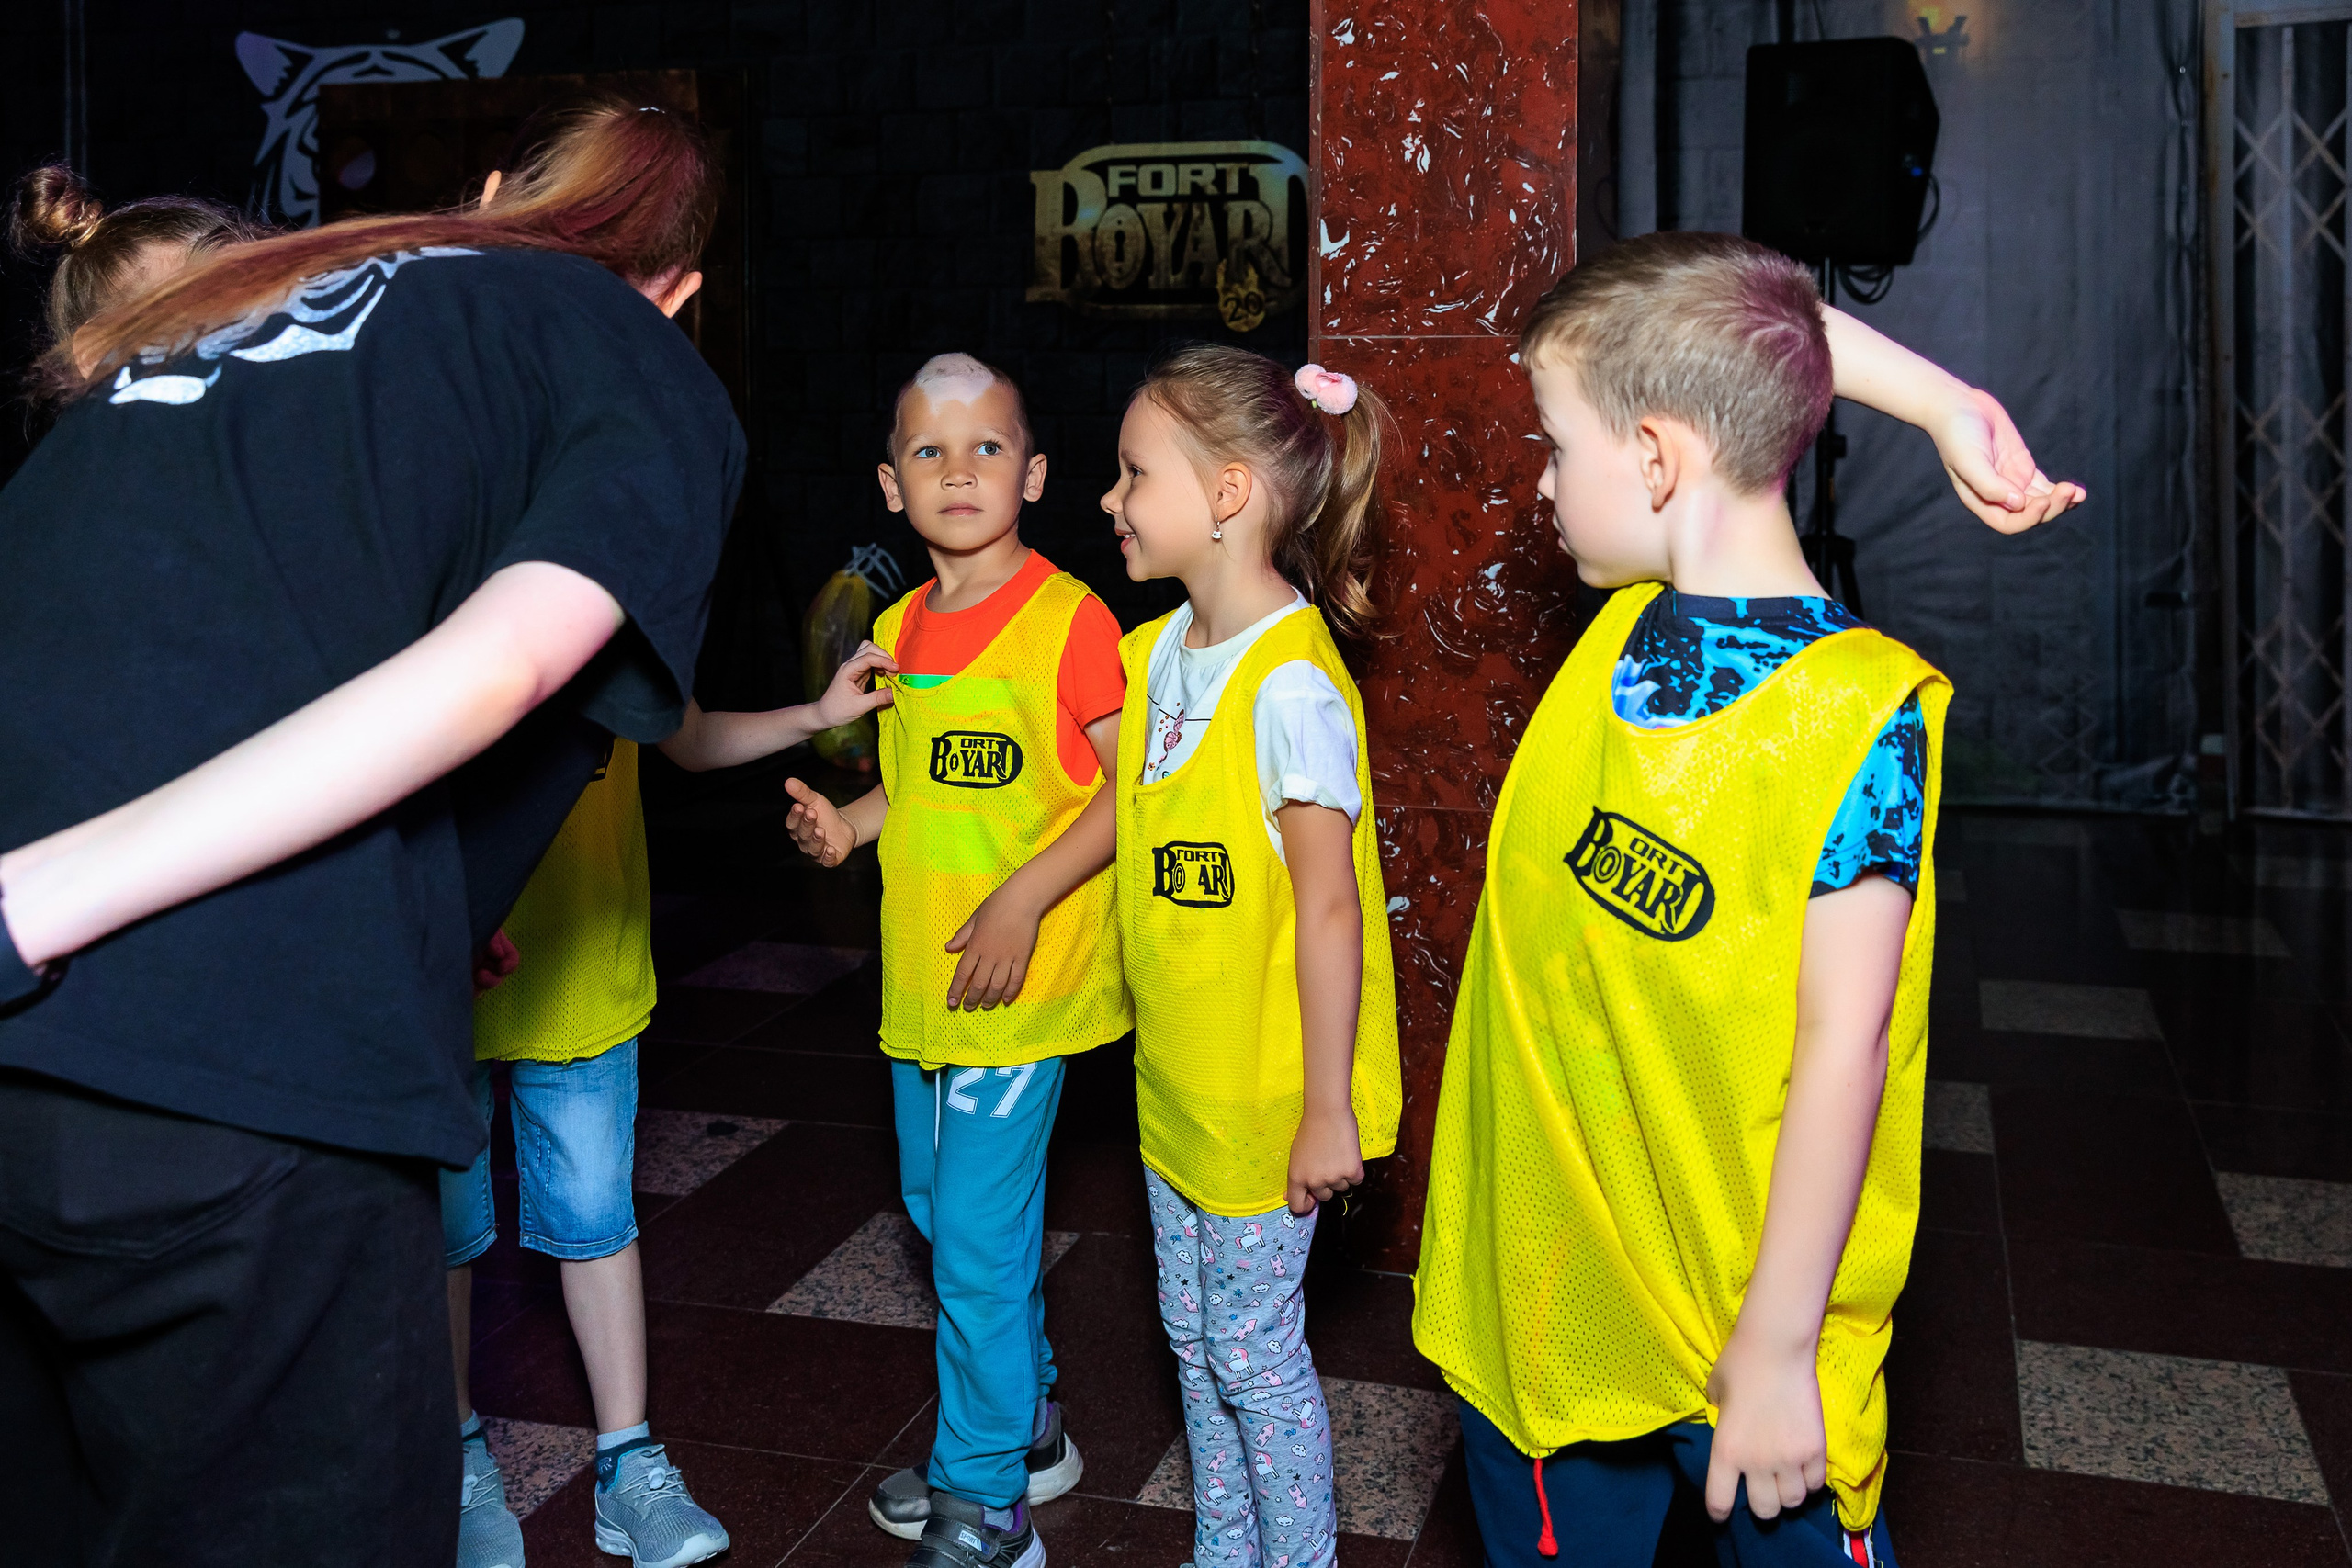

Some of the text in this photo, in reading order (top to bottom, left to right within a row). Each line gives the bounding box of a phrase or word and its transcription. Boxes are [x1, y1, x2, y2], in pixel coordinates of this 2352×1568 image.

[1108, 163, 1248, 197] FORT
[1026, 154, 1308, 308] BOYARD
[1223, 291, 1264, 322] 20
[929, 734, 1023, 786] BOYARD
[1152, 844, 1235, 903] BOARD
[1563, 805, 1715, 941] BOYARD
[946, 1062, 1037, 1118] 27
[960, 1532, 977, 1544] SPORT
